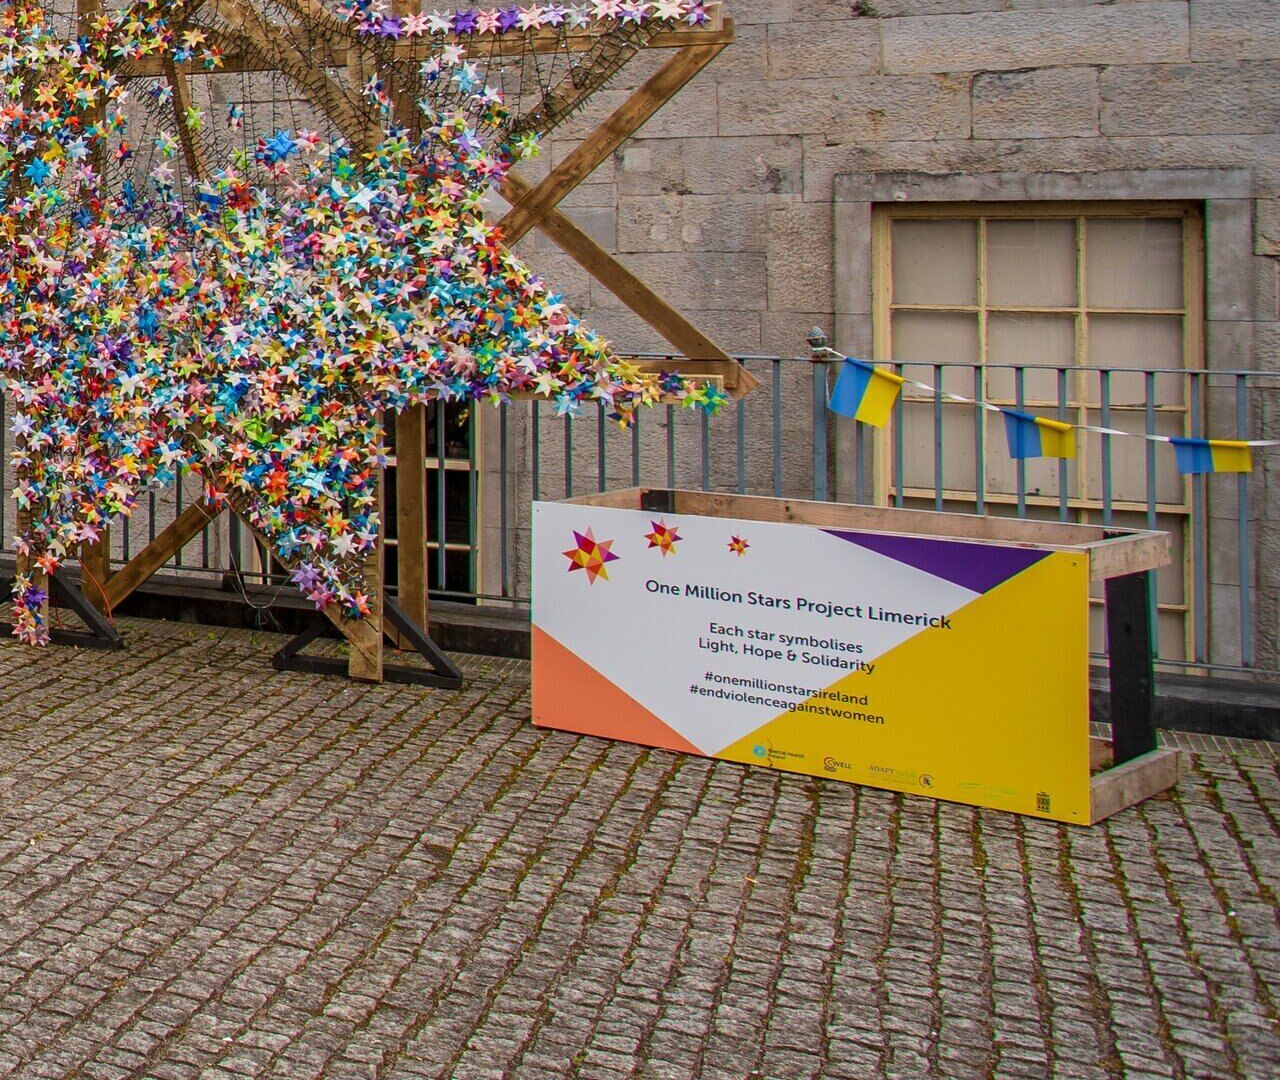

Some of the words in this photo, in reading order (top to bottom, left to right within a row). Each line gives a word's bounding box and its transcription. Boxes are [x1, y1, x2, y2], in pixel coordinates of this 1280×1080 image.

[645, 579, 681, 597] One
[685, 584, 743, 604] Million
[747, 591, 792, 610] Stars
[796, 597, 863, 619] Project
[868, 605, 953, 630] Limerick
[698, 637, 739, 655] Light,
[743, 643, 783, 661] Hope
[786, 649, 798, 661] &
[801, 651, 876, 675] Solidarity
[709, 622, 744, 638] Each
[747, 627, 776, 641] star
[778, 631, 864, 655] symbolises
[689, 683, 886, 725] #endviolenceagainstwomen
[703, 670, 869, 706] #onemillionstarsireland
